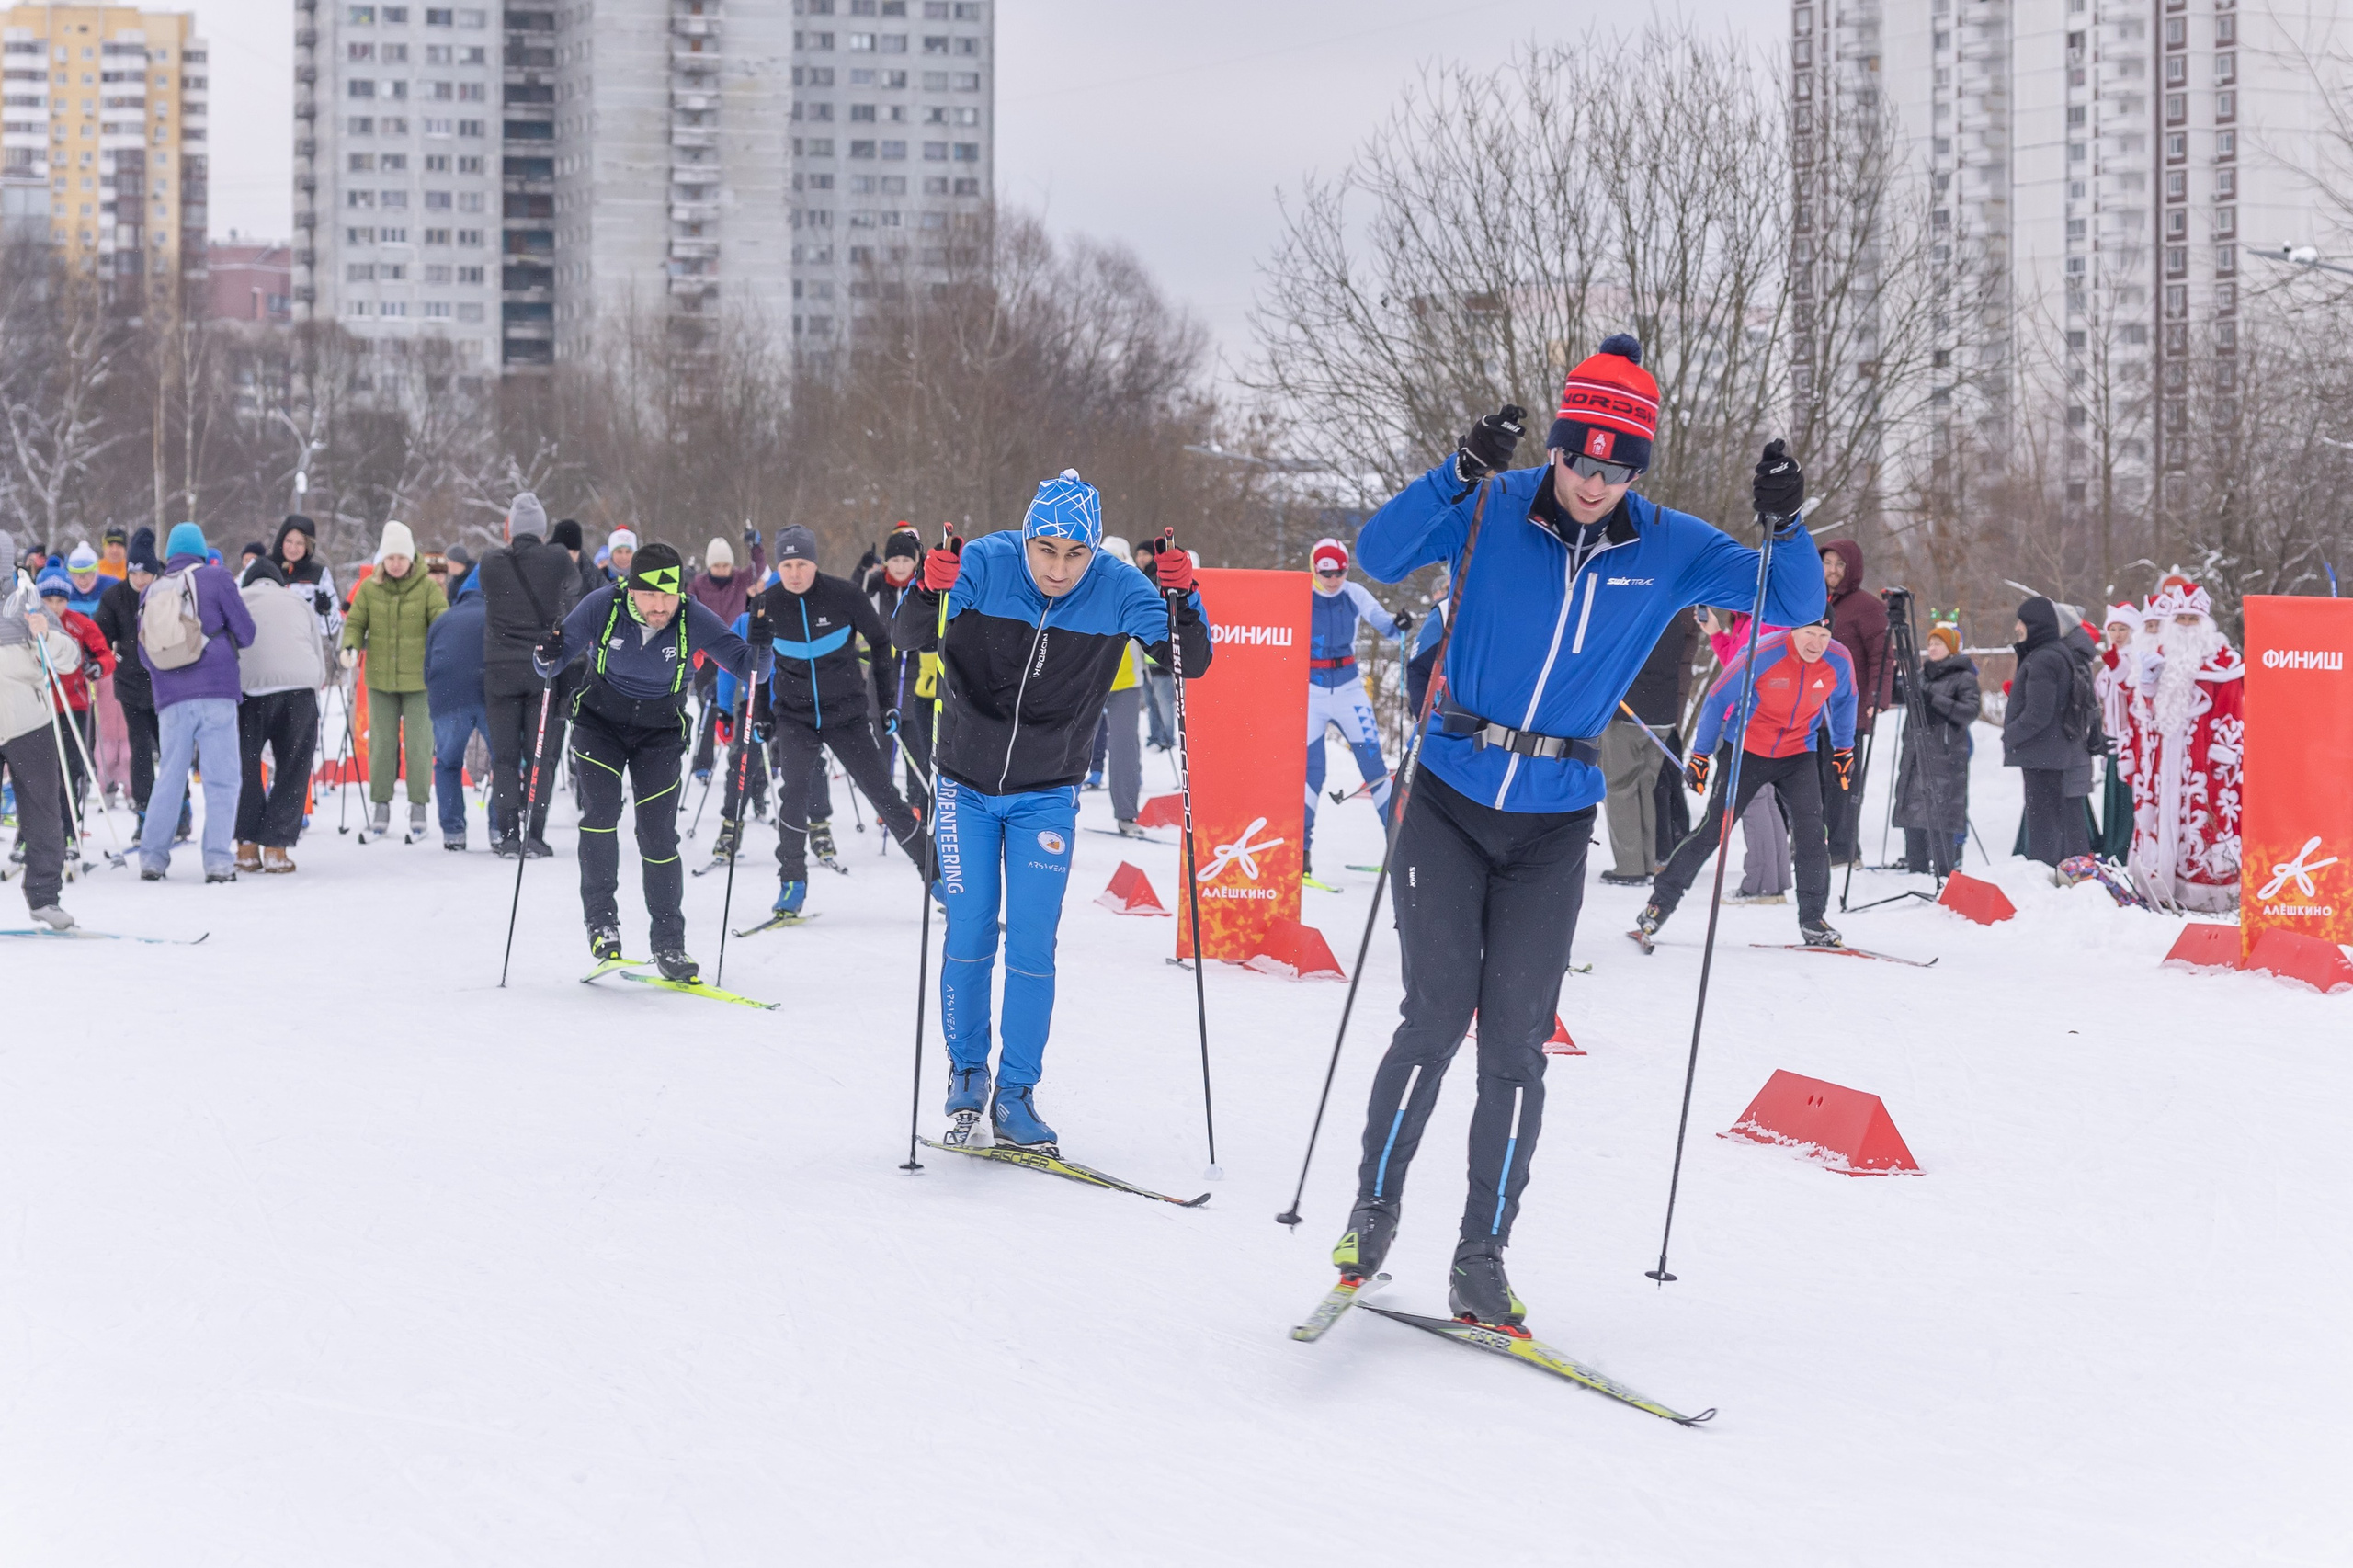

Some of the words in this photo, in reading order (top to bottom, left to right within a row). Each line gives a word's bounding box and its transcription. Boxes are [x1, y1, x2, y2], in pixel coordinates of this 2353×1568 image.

[1210, 624, 1292, 646] ФИНИШ
[1032, 633, 1049, 678] NORDSKI
[1171, 632, 1182, 674] LEKI
[2262, 649, 2343, 670] ФИНИШ
[938, 777, 964, 894] ORIENTEERING
[1202, 885, 1277, 900] АЛЁШКИНО
[2262, 903, 2333, 917] АЛЁШКИНО
[989, 1149, 1050, 1169] FISCHER
[1469, 1326, 1512, 1351] FISCHER
